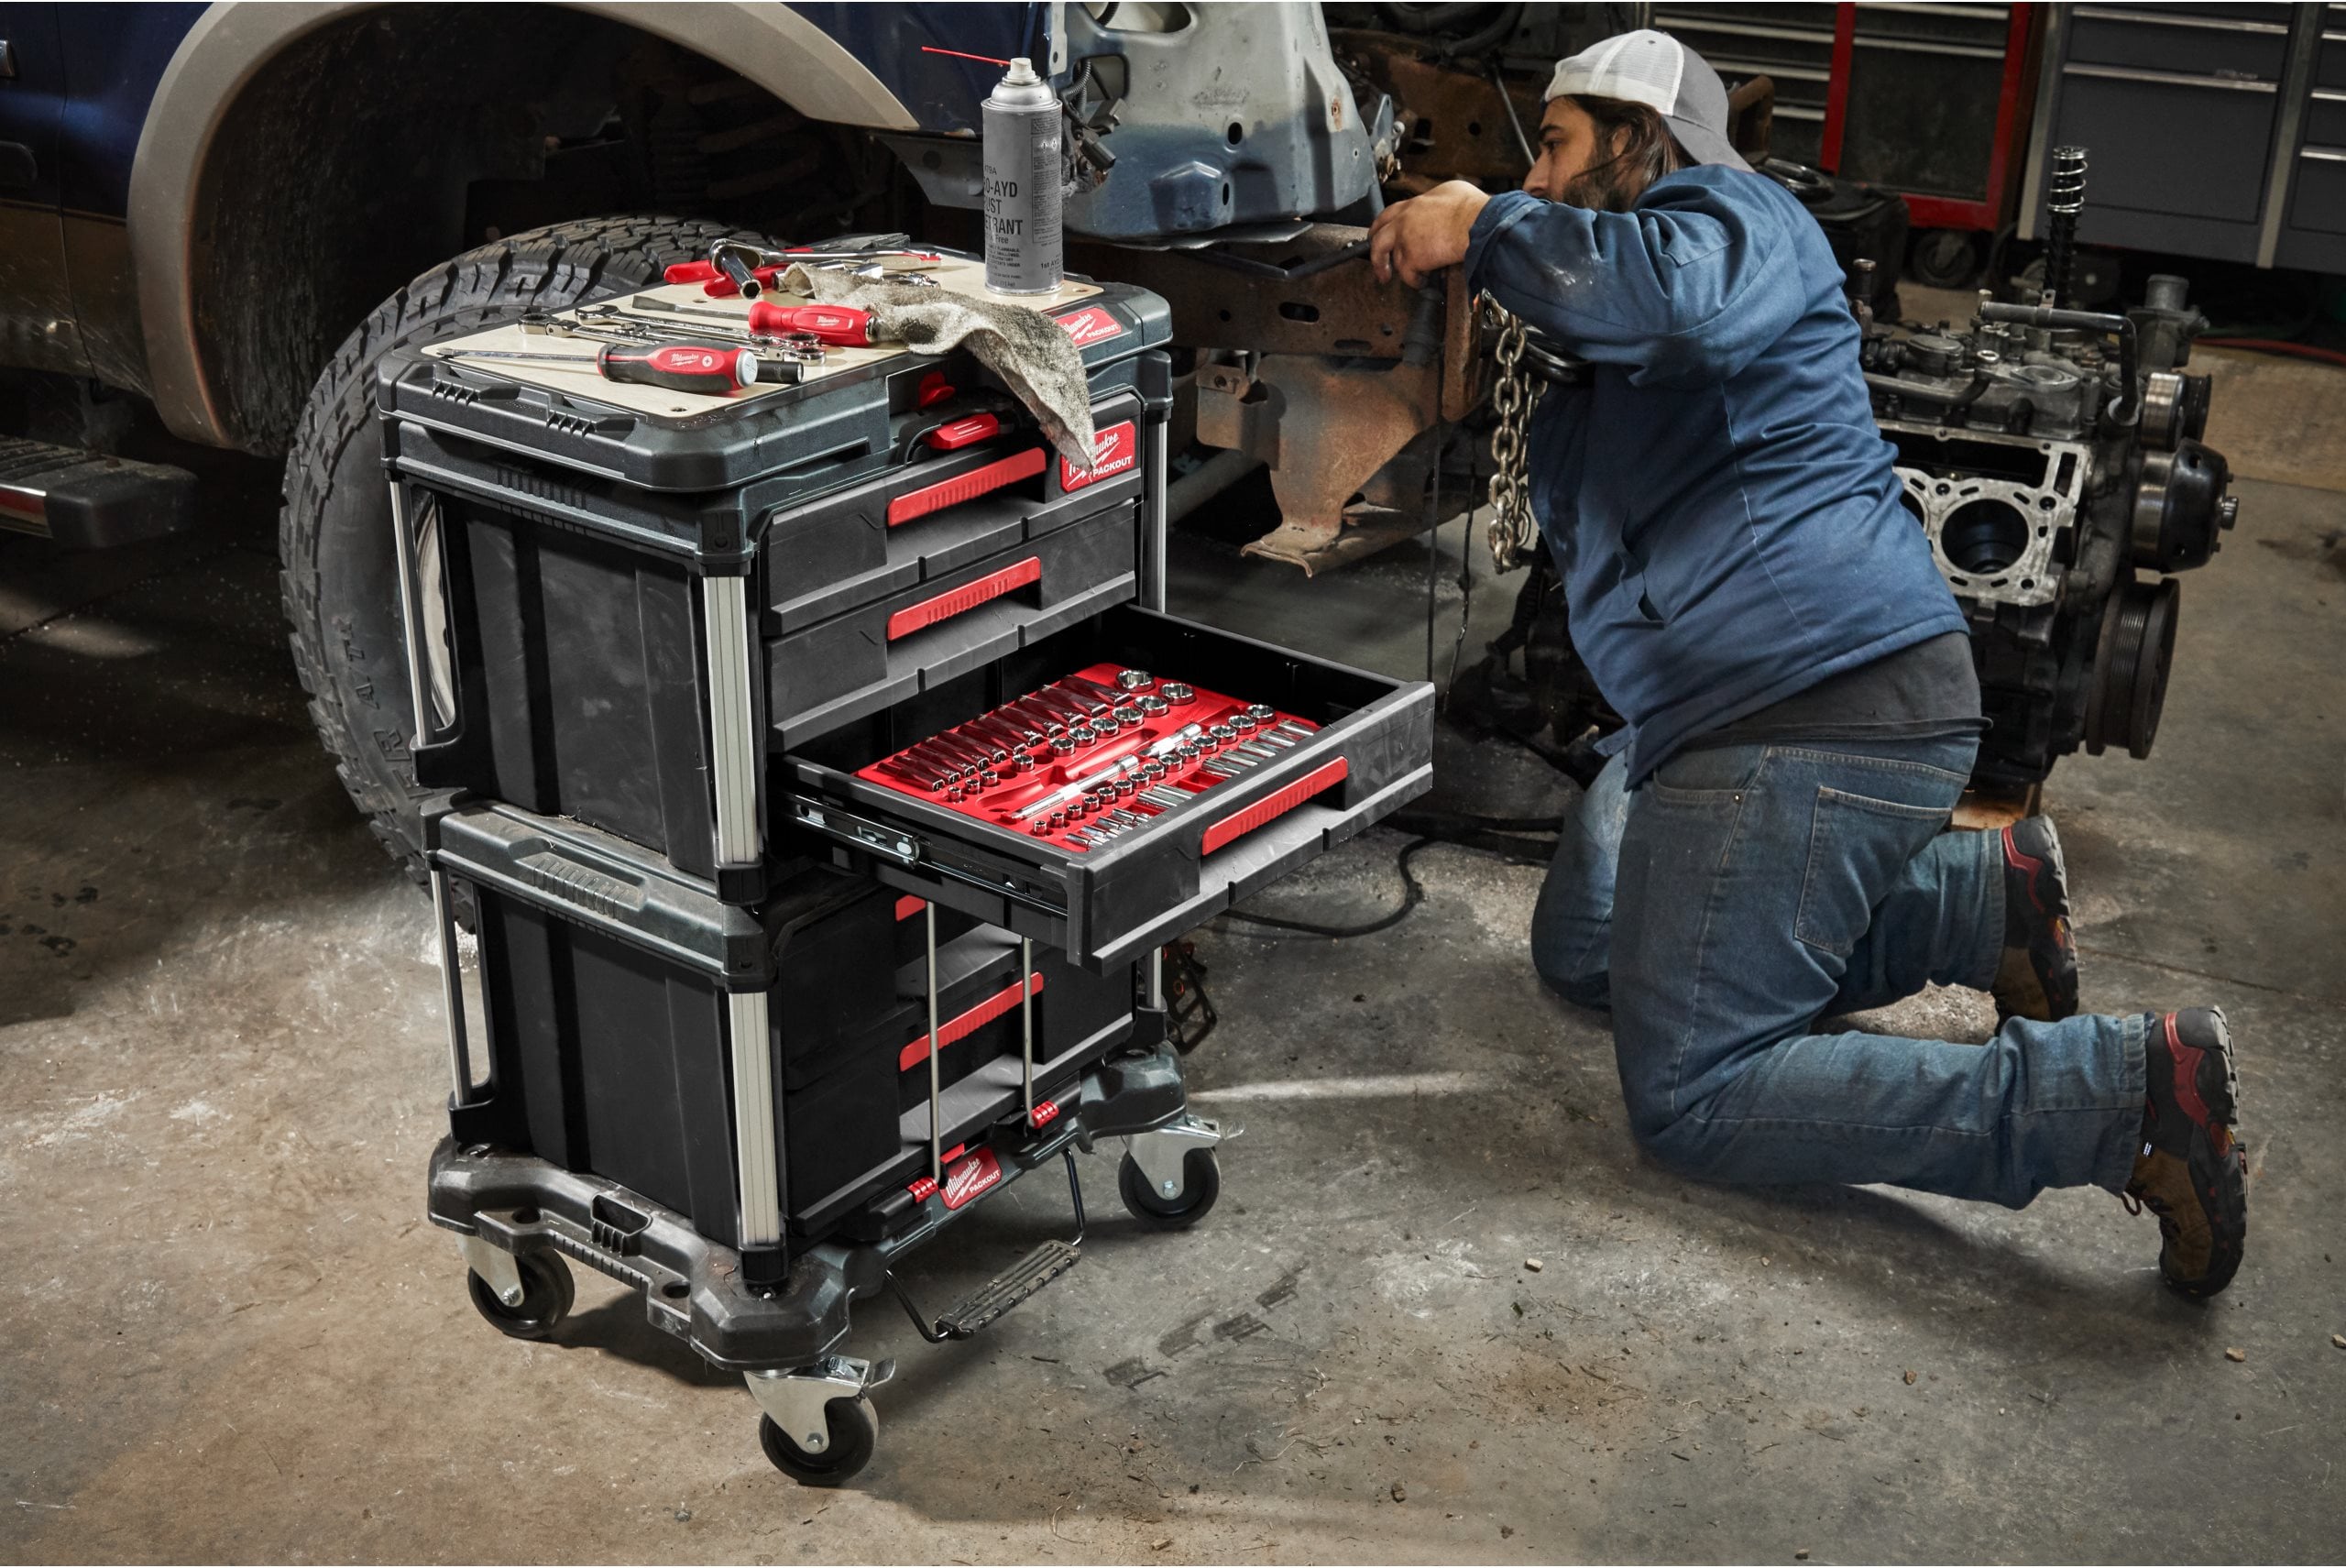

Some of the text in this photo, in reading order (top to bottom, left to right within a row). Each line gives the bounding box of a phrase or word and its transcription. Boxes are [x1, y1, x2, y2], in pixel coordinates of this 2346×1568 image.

[1086, 323, 1119, 338] PACKOUT
[1092, 455, 1133, 477] PACKOUT
[946, 1157, 981, 1199] Milwaukee
[969, 1168, 1000, 1194] PACKOUT
